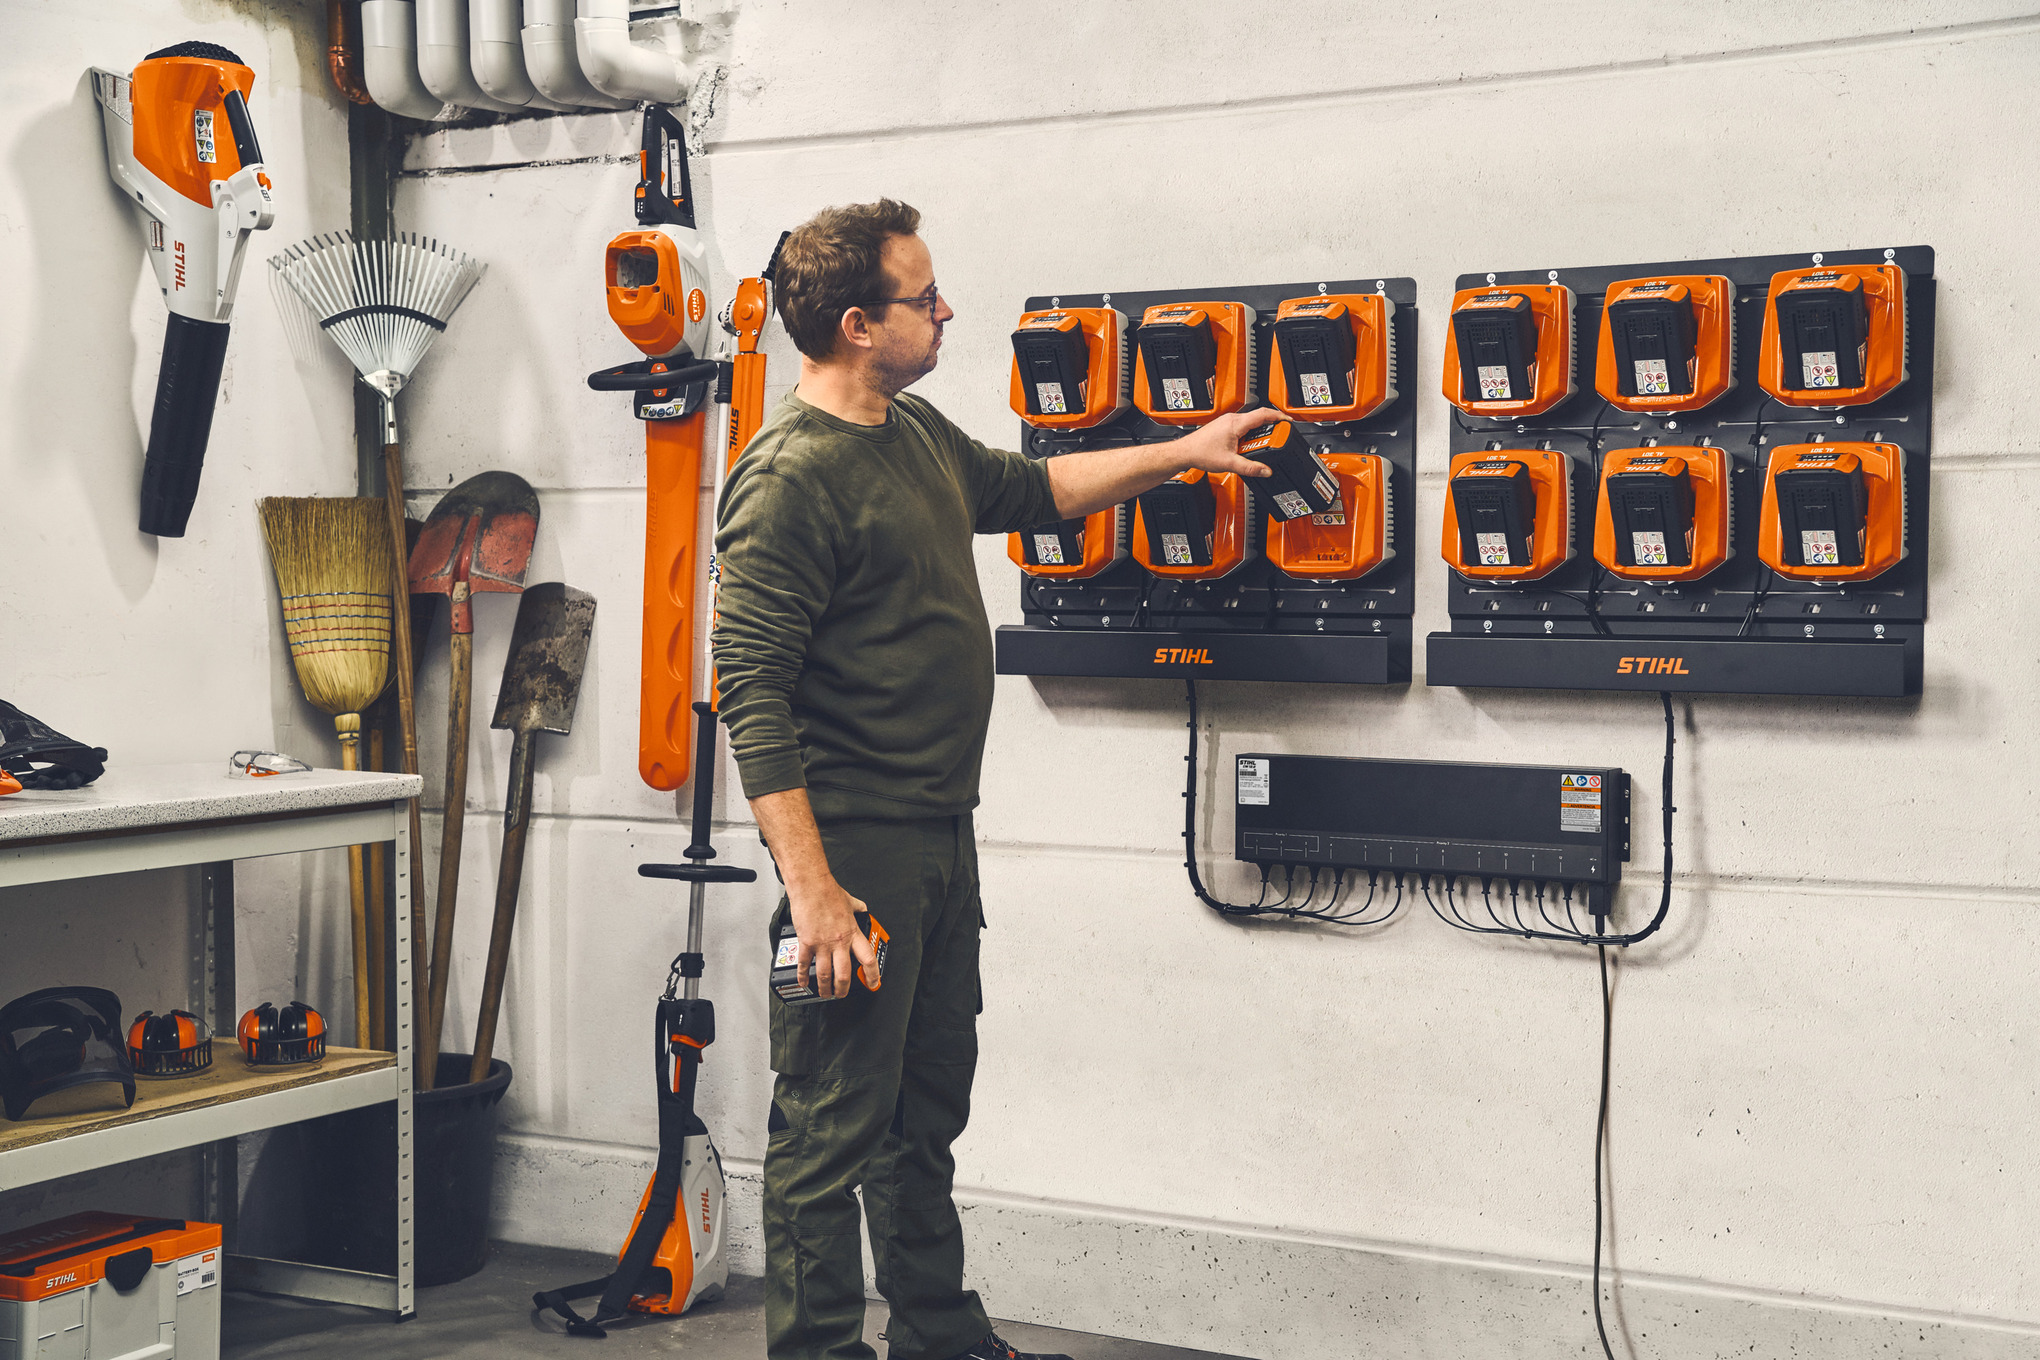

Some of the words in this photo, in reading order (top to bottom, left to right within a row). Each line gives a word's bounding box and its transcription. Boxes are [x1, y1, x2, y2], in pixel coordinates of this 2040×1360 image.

[174, 240, 186, 292] STIHL
[691, 290, 699, 321] STIHL
[729, 407, 739, 450] STIHL
[1241, 438, 1271, 451] STIHL
[1153, 648, 1213, 664] STIHL
[1616, 657, 1689, 674] STIHL
[701, 1187, 711, 1234] STIHL
[46, 1272, 78, 1289] STIHL
